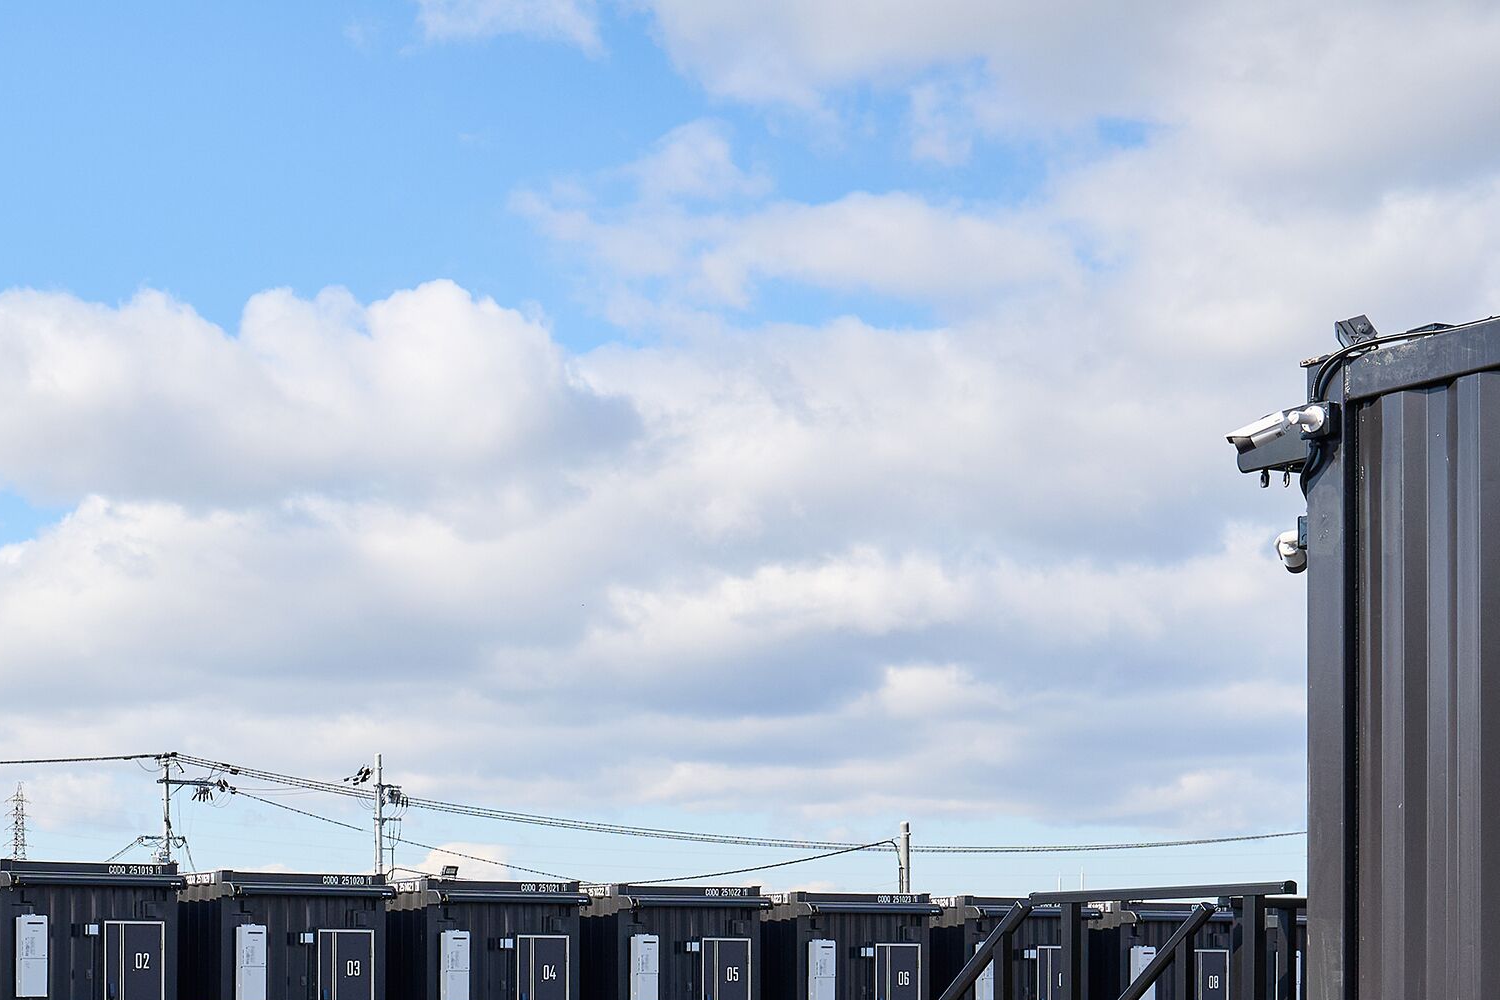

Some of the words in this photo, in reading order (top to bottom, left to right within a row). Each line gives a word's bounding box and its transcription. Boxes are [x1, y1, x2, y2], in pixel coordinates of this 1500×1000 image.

[129, 866, 153, 875] 251019
[135, 952, 150, 969] 02
[347, 960, 360, 976] 03
[543, 964, 557, 980] 04
[727, 966, 739, 981] 05
[898, 971, 910, 986] 06
[1208, 975, 1219, 989] 08
